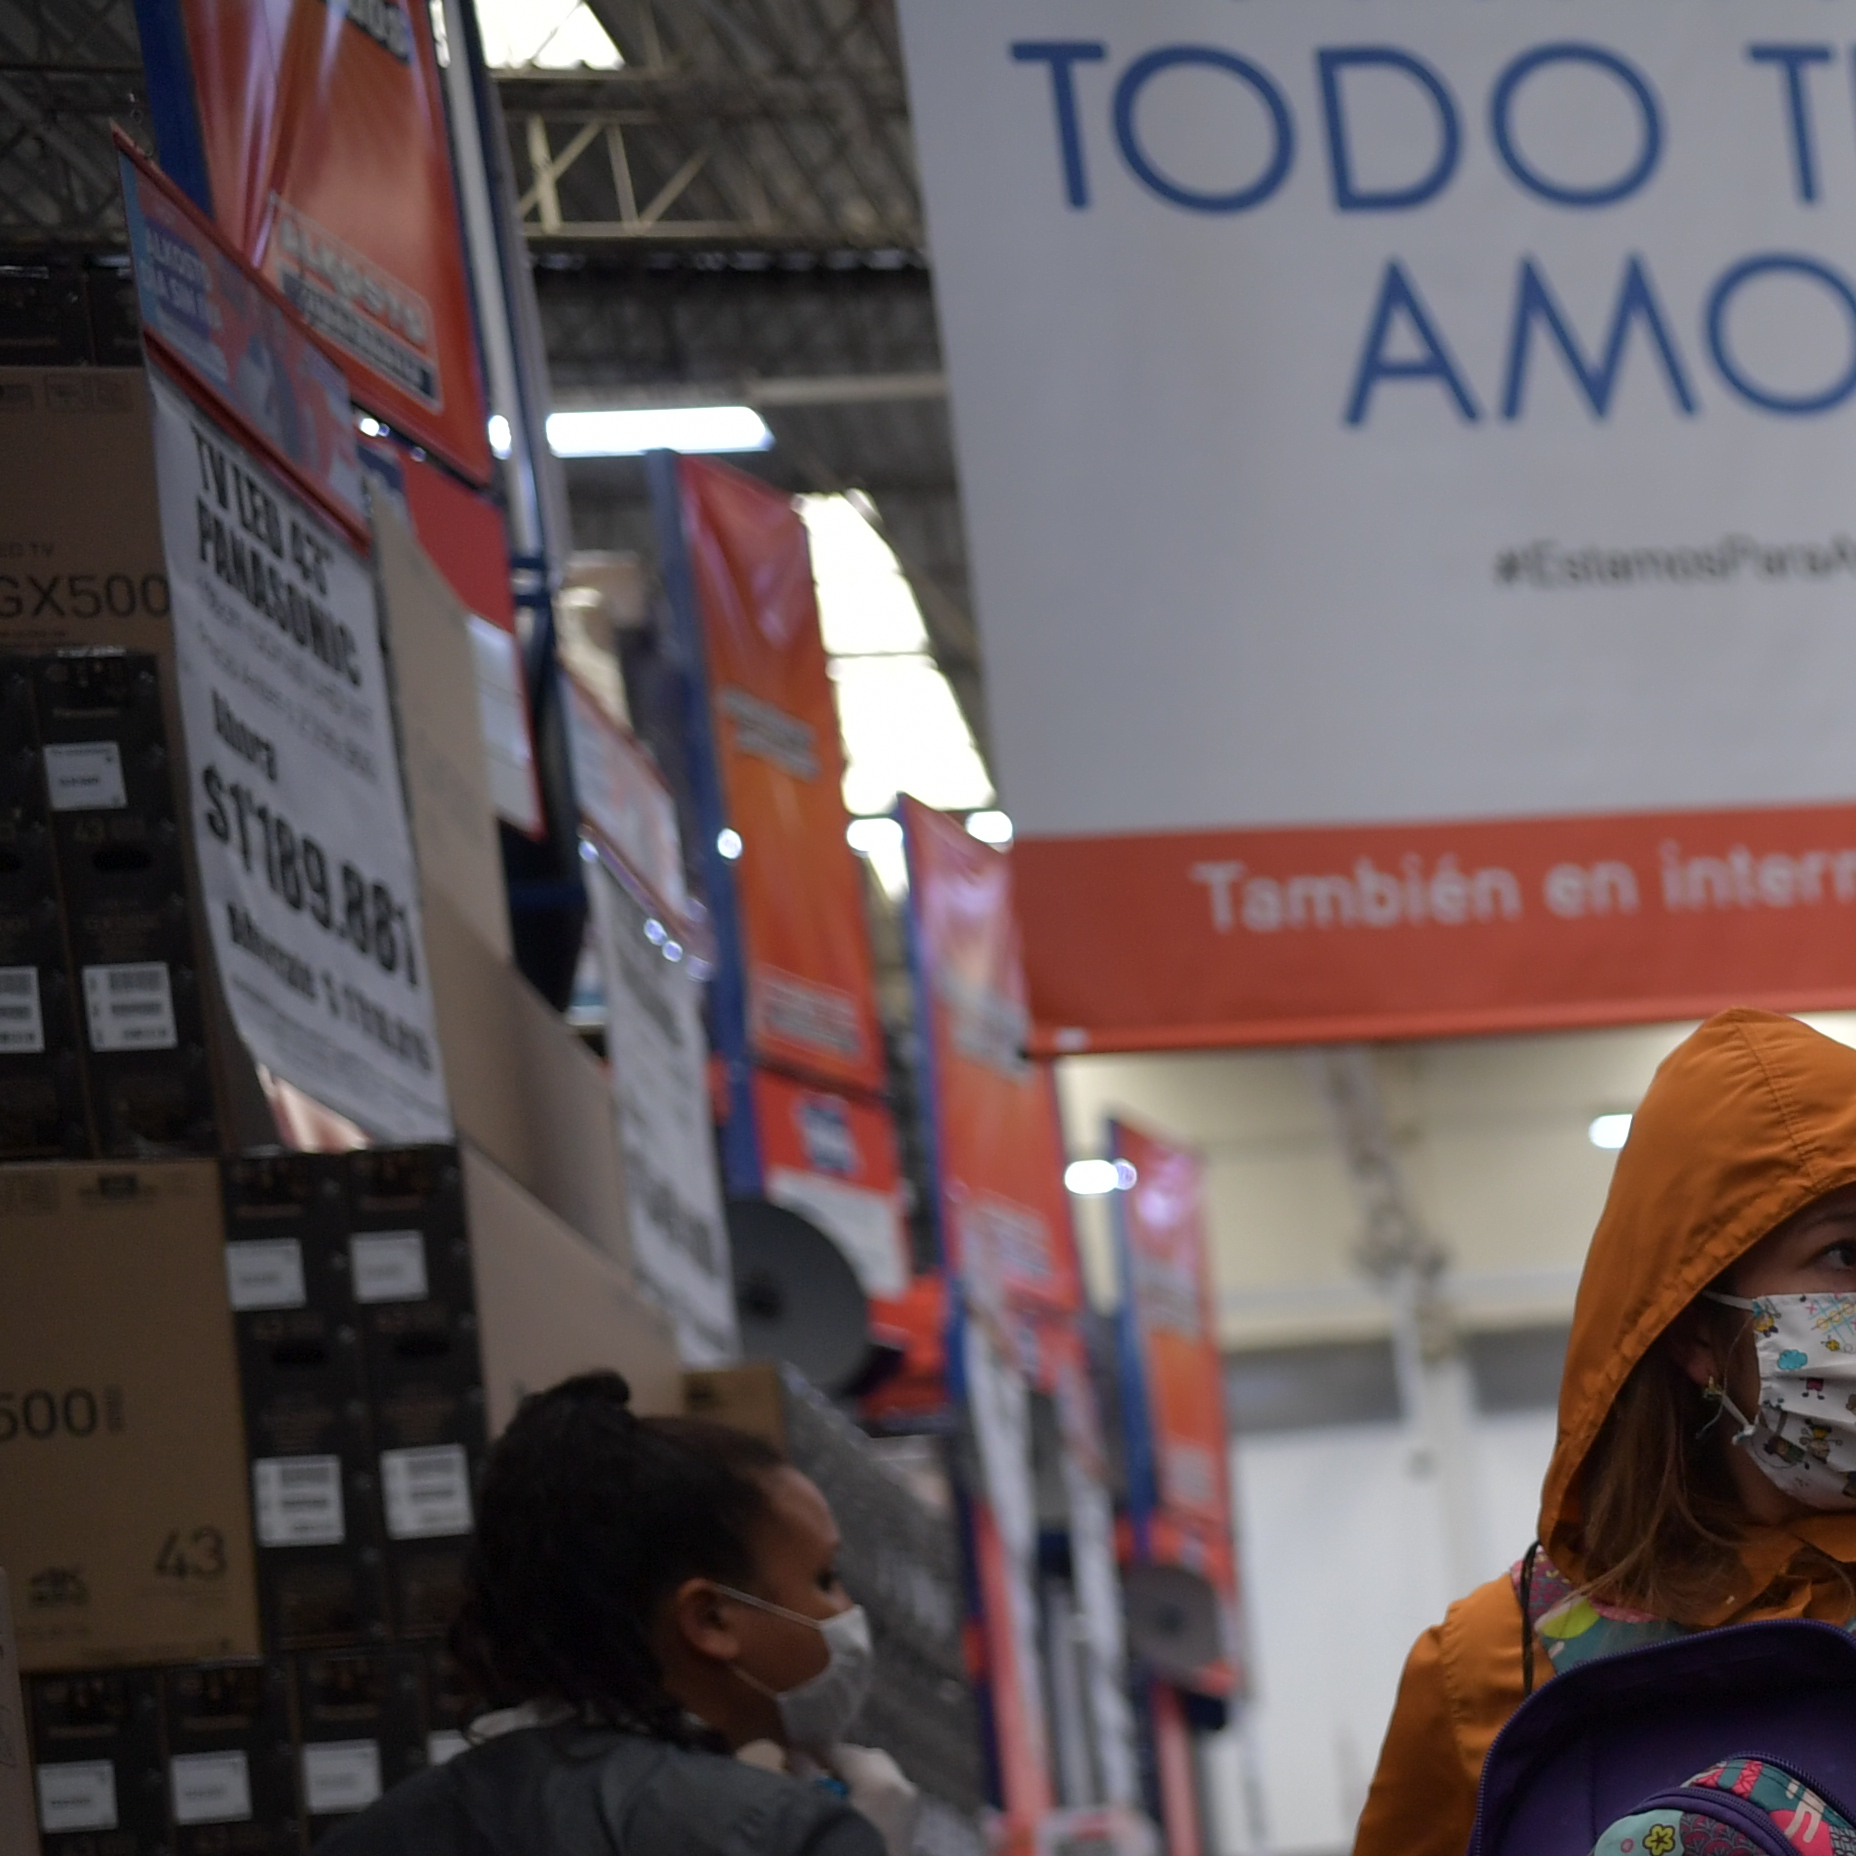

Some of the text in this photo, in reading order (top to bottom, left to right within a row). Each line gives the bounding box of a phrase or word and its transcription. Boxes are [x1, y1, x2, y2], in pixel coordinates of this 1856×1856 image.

[1009, 41, 1664, 213] TODO
[195, 494, 362, 689] PANASONIC
[1192, 850, 1521, 933] También
[1543, 860, 1641, 919] en
[154, 1526, 228, 1581] 43
